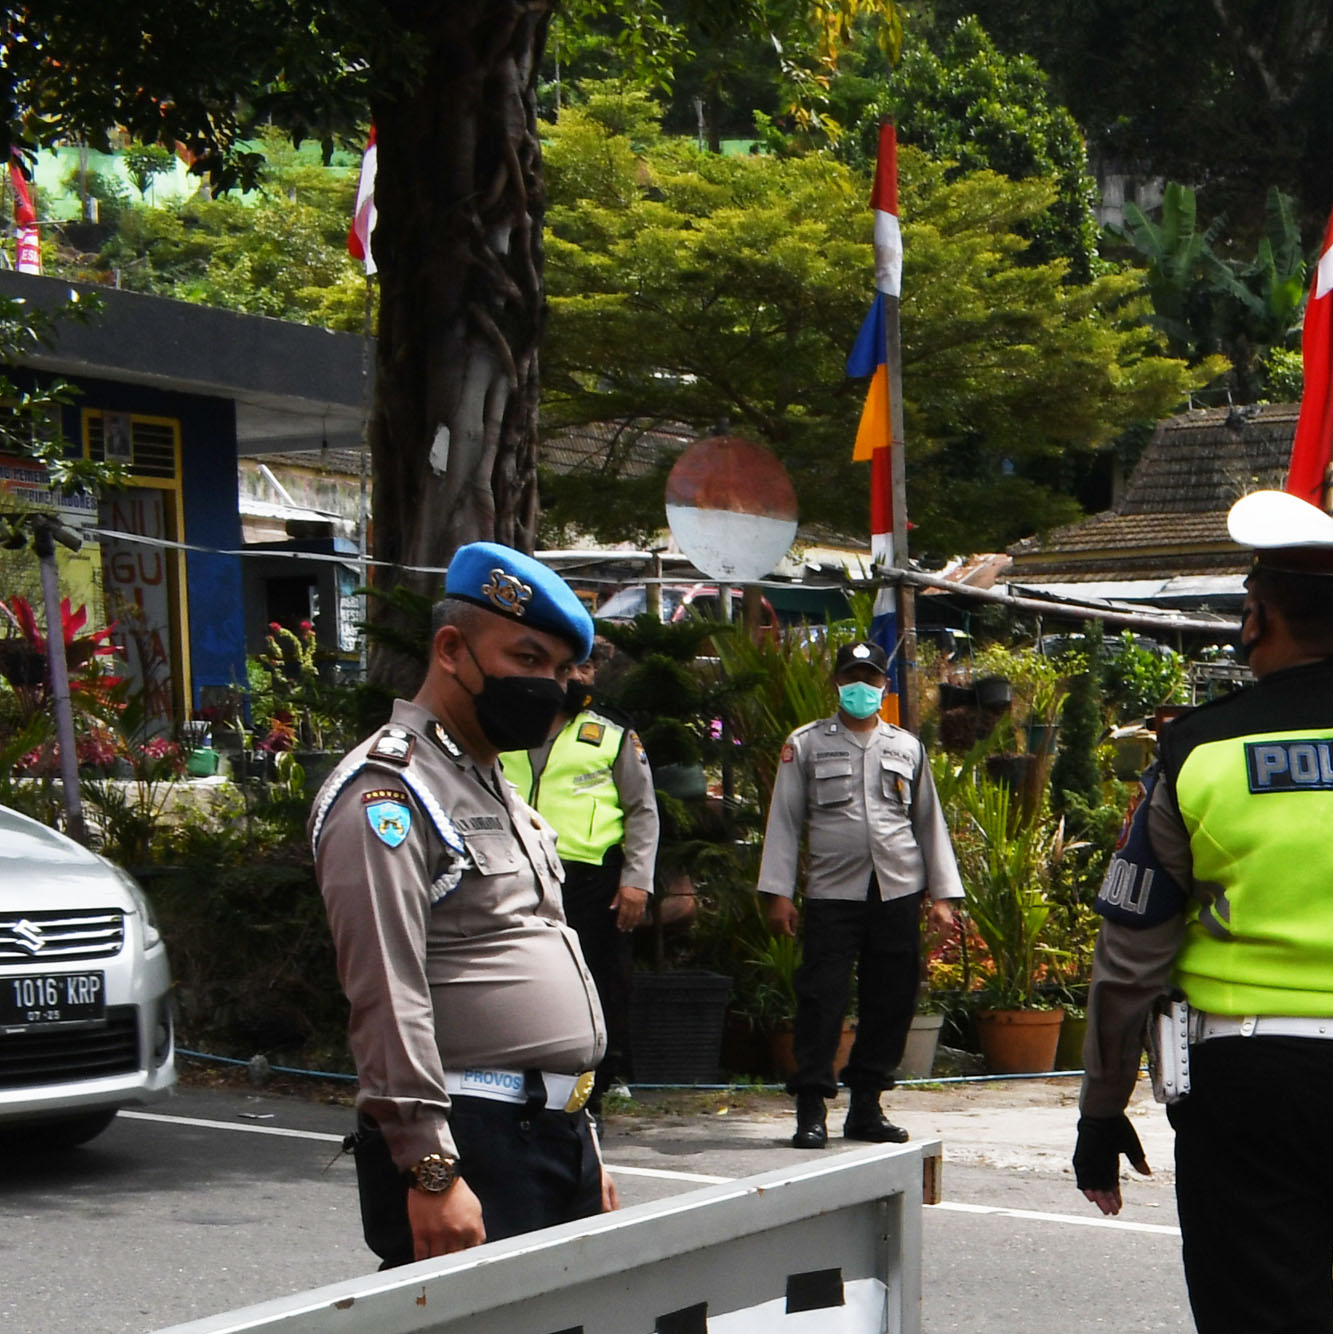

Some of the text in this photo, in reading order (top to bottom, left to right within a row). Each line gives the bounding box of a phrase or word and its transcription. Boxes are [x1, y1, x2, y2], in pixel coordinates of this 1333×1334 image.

[366, 790, 406, 799] PROVOS
[14, 976, 100, 1007] 1016 KRP
[464, 1070, 521, 1090] PROVOS
